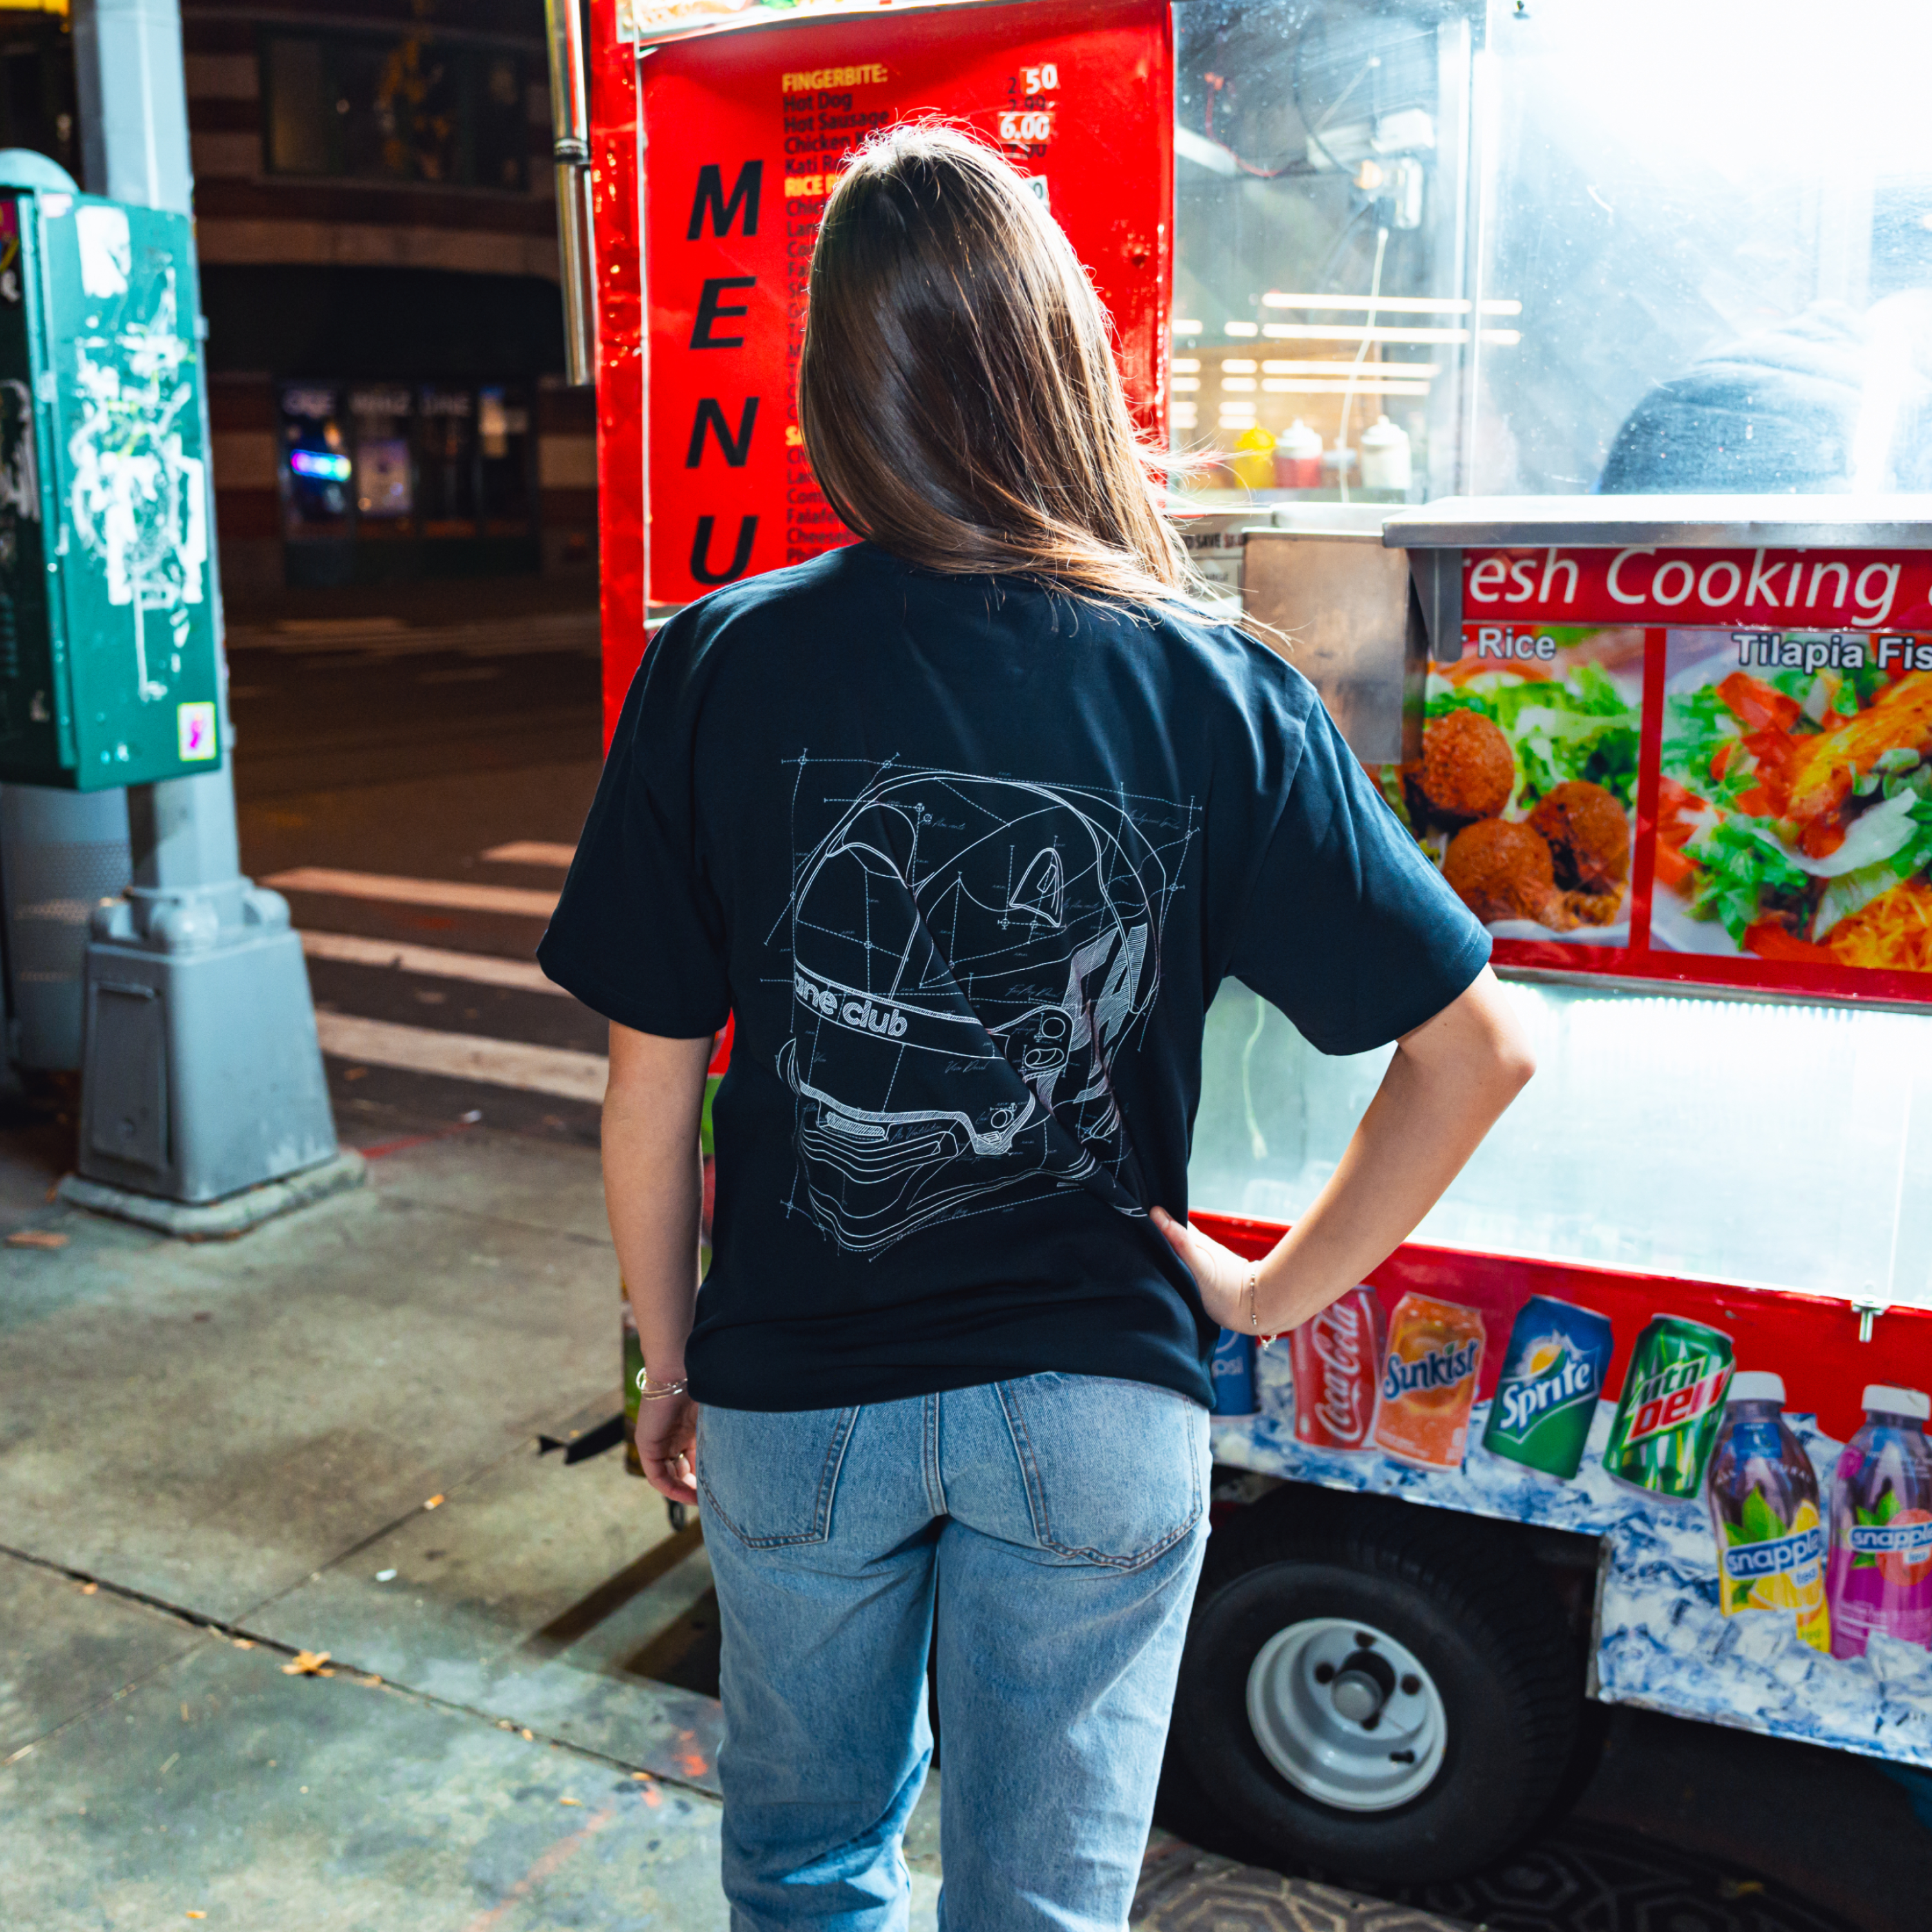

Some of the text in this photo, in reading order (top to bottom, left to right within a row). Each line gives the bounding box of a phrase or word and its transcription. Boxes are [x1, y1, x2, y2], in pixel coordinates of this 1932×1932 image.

[782, 63, 889, 93] FINGERBITE:
[782, 91, 853, 113] Hot Dog
[1007, 95, 1046, 113] 299
[783, 110, 889, 133] Hot Sausage
[1000, 115, 1050, 140] 6.00
[784, 133, 851, 155] Chicken
[784, 155, 819, 175] Kati
[784, 174, 824, 198] RICE
[686, 159, 764, 585] MENU
[1606, 547, 1902, 627] Cooking
[1478, 627, 1557, 661] Rice
[1732, 632, 1865, 676] Tilapia
[842, 999, 907, 1037] club
[1383, 1339, 1481, 1401] Sunkist
[1500, 1360, 1591, 1430] Sprite
[1727, 1531, 1821, 1574] snapple
